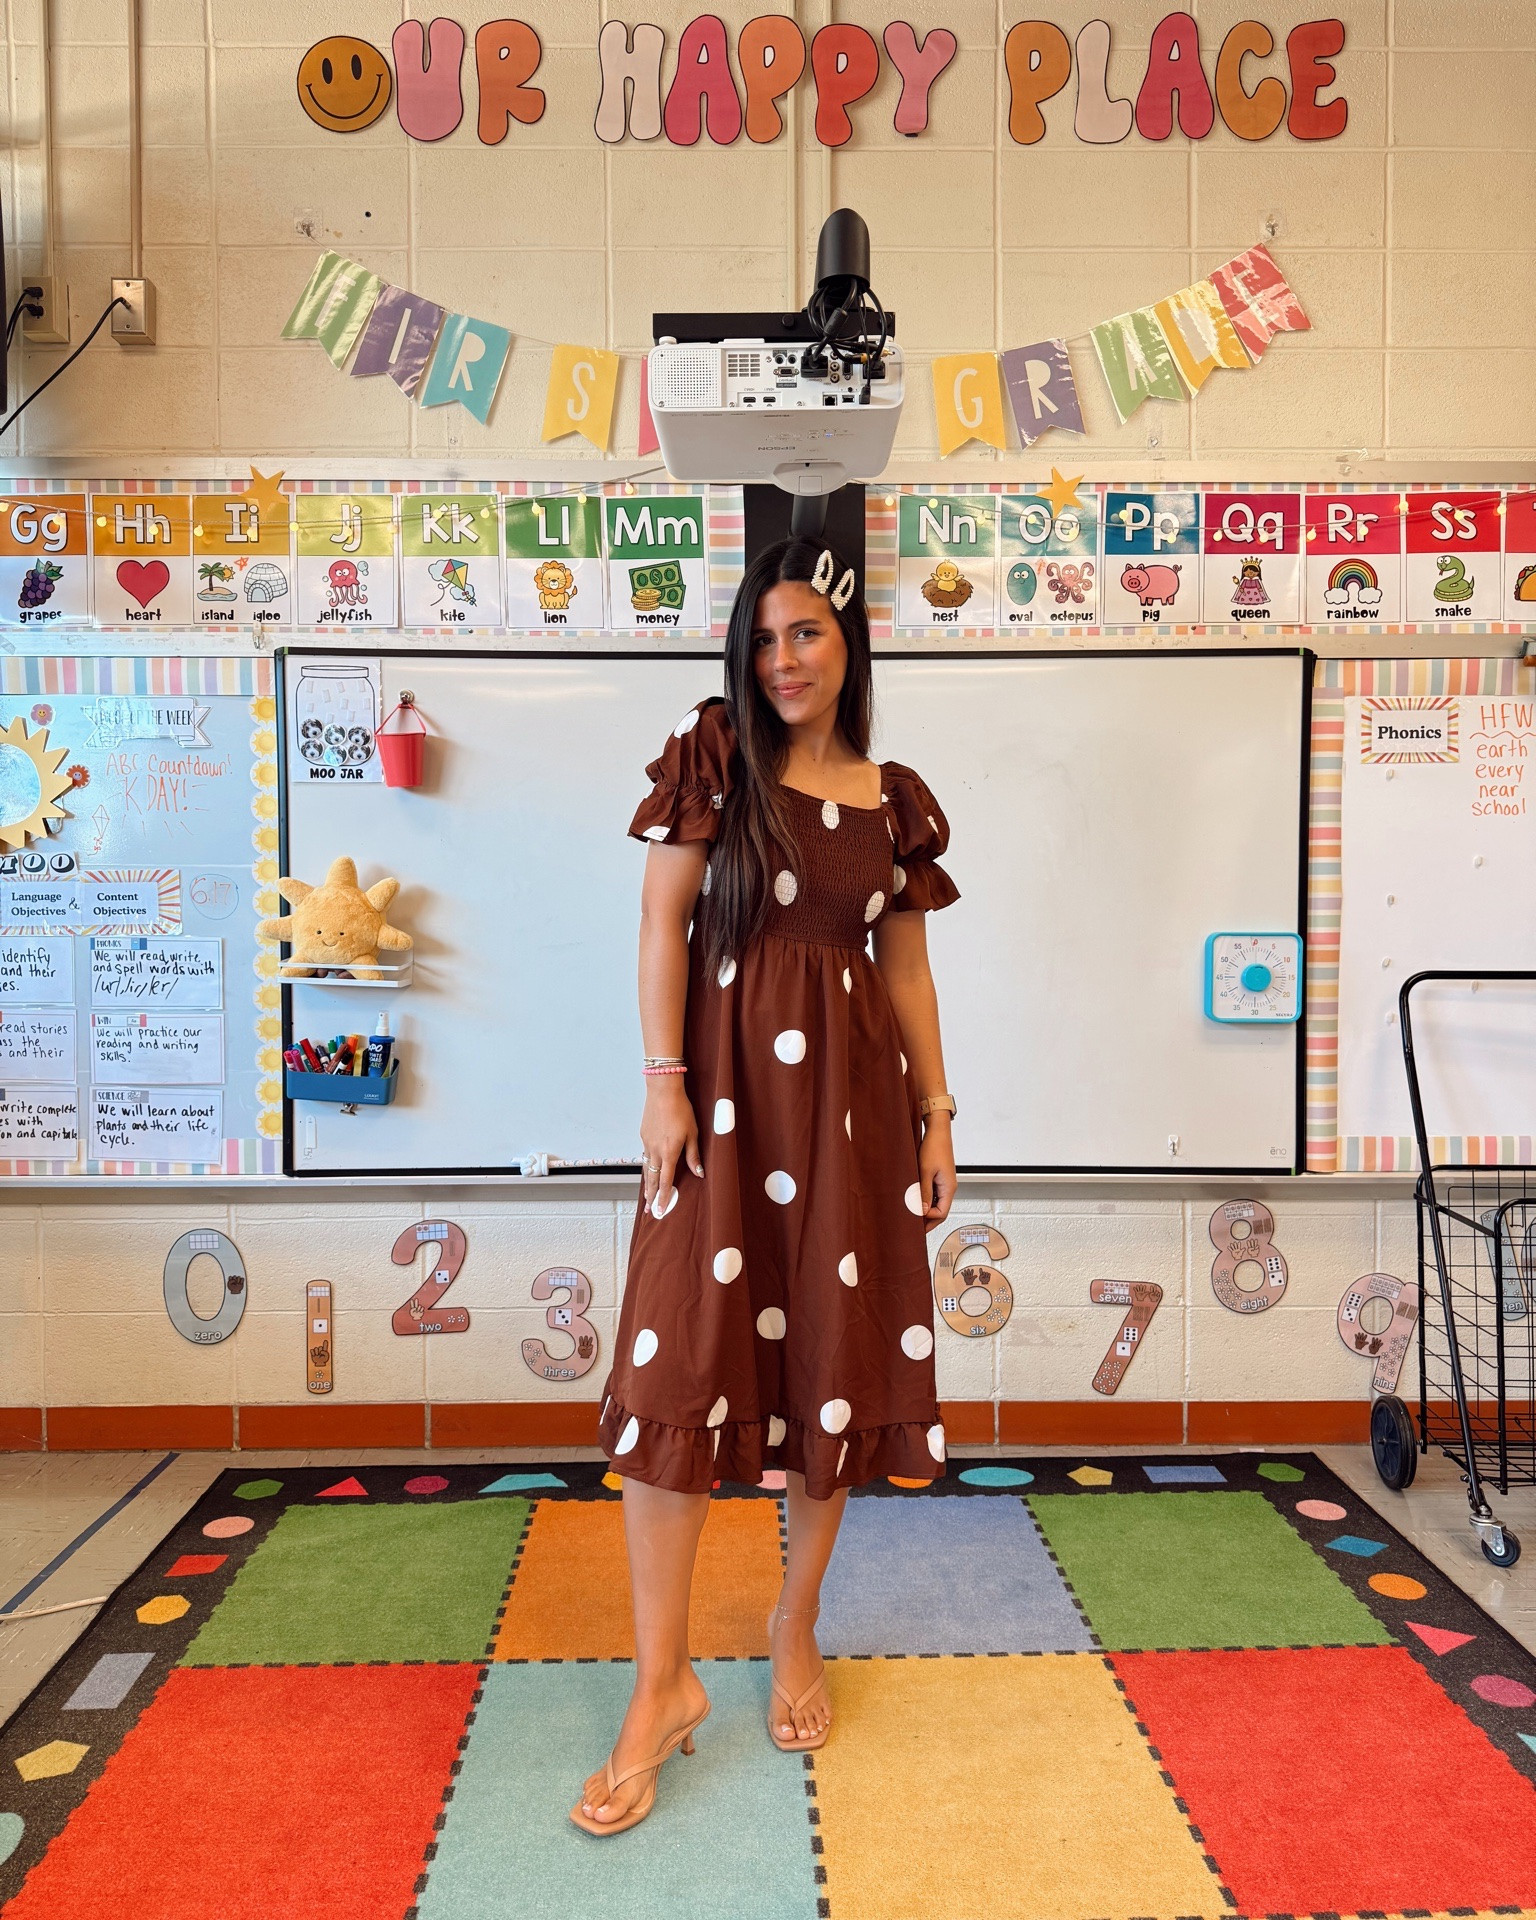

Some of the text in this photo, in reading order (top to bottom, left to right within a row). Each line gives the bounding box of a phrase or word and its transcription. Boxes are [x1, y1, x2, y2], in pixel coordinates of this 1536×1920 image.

[594, 14, 957, 146] HAPPY
[1004, 12, 1348, 145] PLACE
[10, 504, 68, 552] Gg
[114, 503, 171, 544] Hh
[330, 504, 363, 552] Jj
[421, 503, 480, 544] Kk
[613, 506, 699, 546] Mm
[917, 504, 977, 545] Nn
[1018, 504, 1080, 544] Oo
[1124, 502, 1180, 551] Pp
[1221, 502, 1284, 551] Qq
[1327, 503, 1380, 543] Rr
[1431, 501, 1478, 541] Ss
[125, 608, 161, 621] heart
[201, 609, 234, 621] island
[253, 610, 281, 622] igloo
[317, 610, 372, 623] jellyfish
[440, 609, 465, 622] kite
[544, 611, 567, 624] lion
[932, 611, 959, 622] nest
[1009, 611, 1033, 622] oval
[1050, 610, 1094, 623] octopus
[1142, 610, 1160, 622] pig
[1231, 608, 1271, 621] queen
[1327, 607, 1379, 619] rainbow
[1435, 605, 1471, 618] snake
[636, 612, 680, 626] money
[166, 710, 193, 725] WEEK
[1481, 703, 1534, 729] HFW
[1377, 725, 1442, 739] Phonics
[1476, 739, 1528, 758] earth
[310, 768, 364, 779] MOO JAR
[1475, 763, 1524, 782] every
[148, 775, 188, 813] DAY!
[1479, 784, 1519, 799] near
[1471, 798, 1526, 816] school
[11, 892, 62, 903] Language
[97, 892, 138, 902] Content
[11, 907, 66, 917] Objectives
[93, 906, 147, 916] Objectives
[2, 947, 50, 969] identify
[94, 950, 111, 962] We
[115, 950, 136, 962] will
[1, 964, 56, 978] and their
[93, 962, 112, 972] and
[149, 961, 185, 976] words
[188, 960, 215, 976] with
[31, 1022, 68, 1035] stories
[96, 1026, 202, 1039] We will practice our
[22, 1035, 40, 1048] the
[96, 1038, 199, 1053] reading and writing
[9, 1048, 28, 1058] and
[33, 1047, 65, 1059] their
[0, 1099, 77, 1117] write complete
[97, 1103, 215, 1117] We will learn about
[17, 1115, 43, 1126] with
[96, 1118, 208, 1135] plants and their life
[16, 1128, 36, 1138] and
[1209, 1199, 1289, 1314] 8
[391, 1219, 470, 1336] 2
[934, 1223, 1014, 1338] 6
[163, 1227, 247, 1345] 0
[1098, 1291, 1133, 1305] seven
[1240, 1294, 1269, 1312] eight
[1502, 1301, 1524, 1312] ten
[419, 1321, 442, 1333] two
[521, 1267, 599, 1381] 3
[969, 1324, 986, 1336] six
[194, 1329, 222, 1342] zero
[306, 1279, 333, 1394] 1
[1090, 1279, 1164, 1396] 7
[1337, 1272, 1427, 1394] 9
[543, 1365, 576, 1378] three
[309, 1379, 331, 1390] one
[1373, 1376, 1396, 1391] nine
